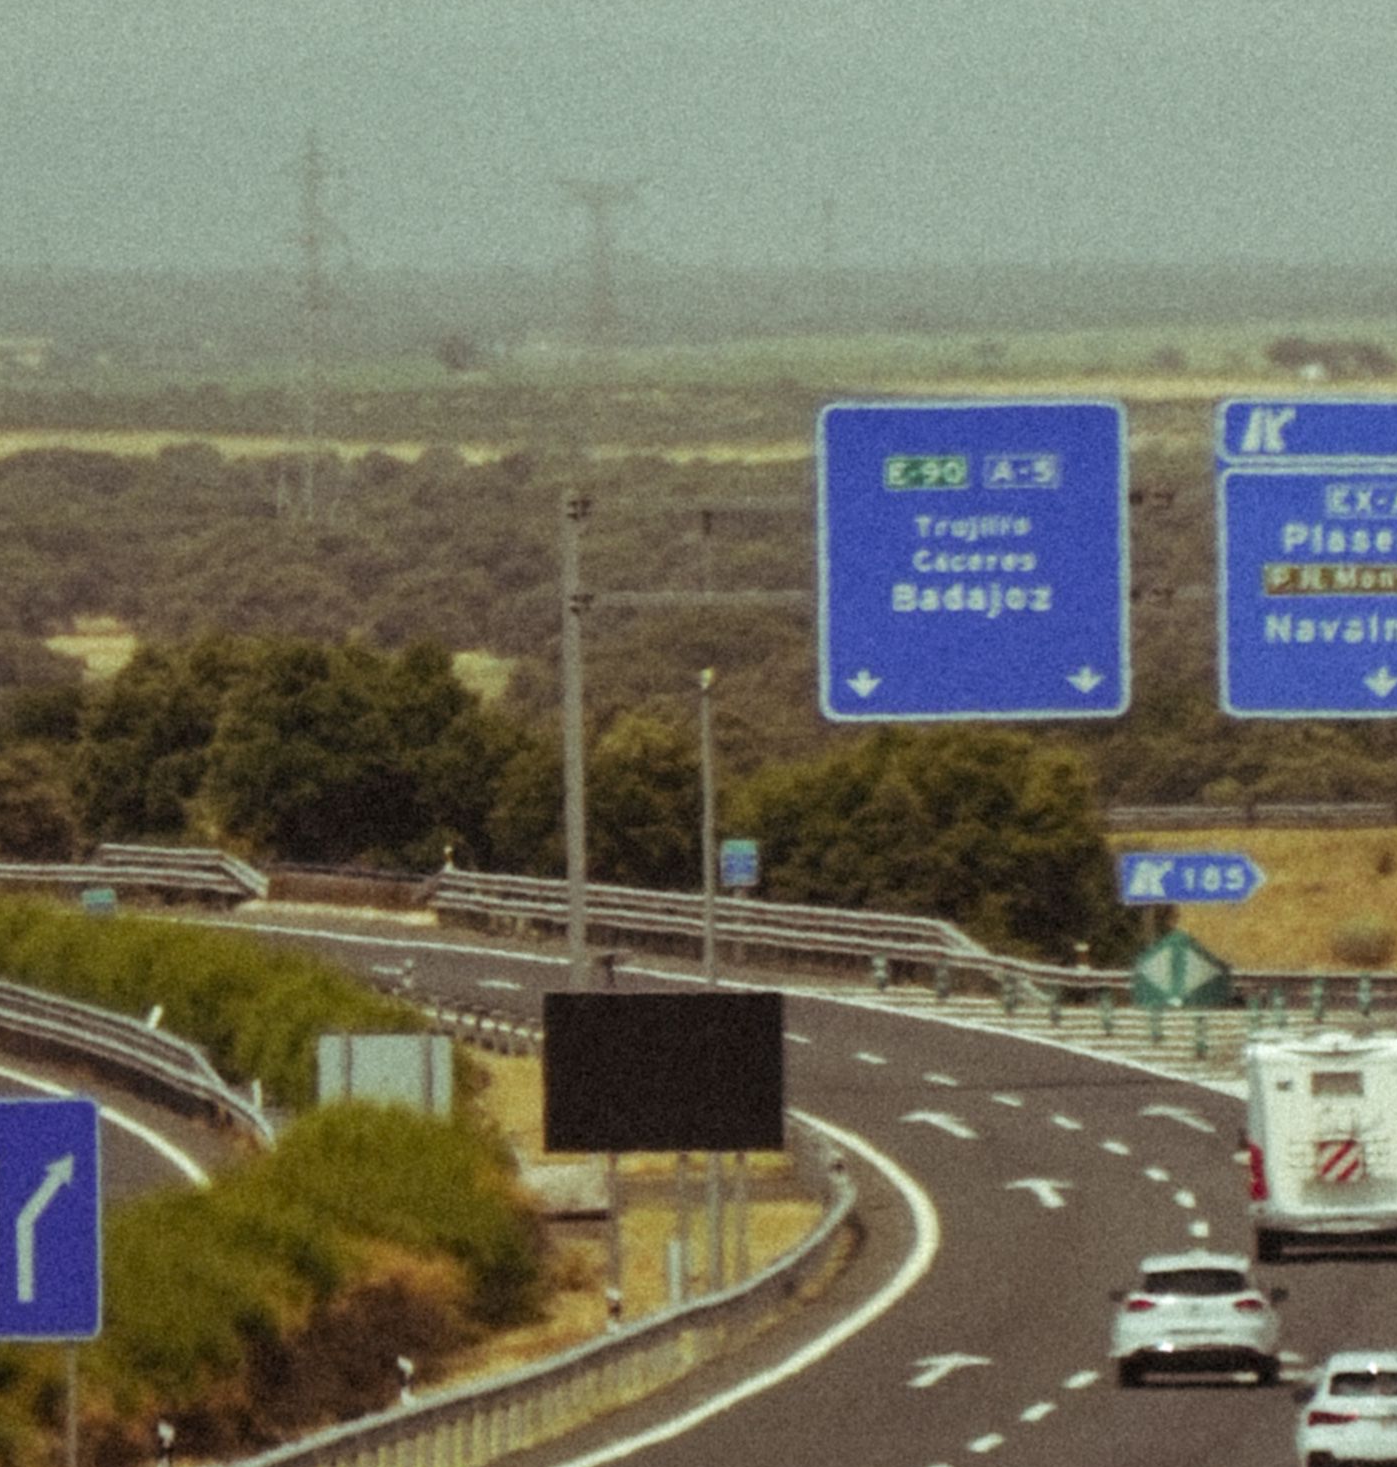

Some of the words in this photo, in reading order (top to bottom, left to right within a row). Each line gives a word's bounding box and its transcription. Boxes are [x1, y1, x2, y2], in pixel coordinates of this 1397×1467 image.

[889, 460, 965, 485] E-90
[990, 459, 1053, 484] A-5
[892, 583, 1052, 619] Badajoz
[1183, 865, 1246, 892] 185
